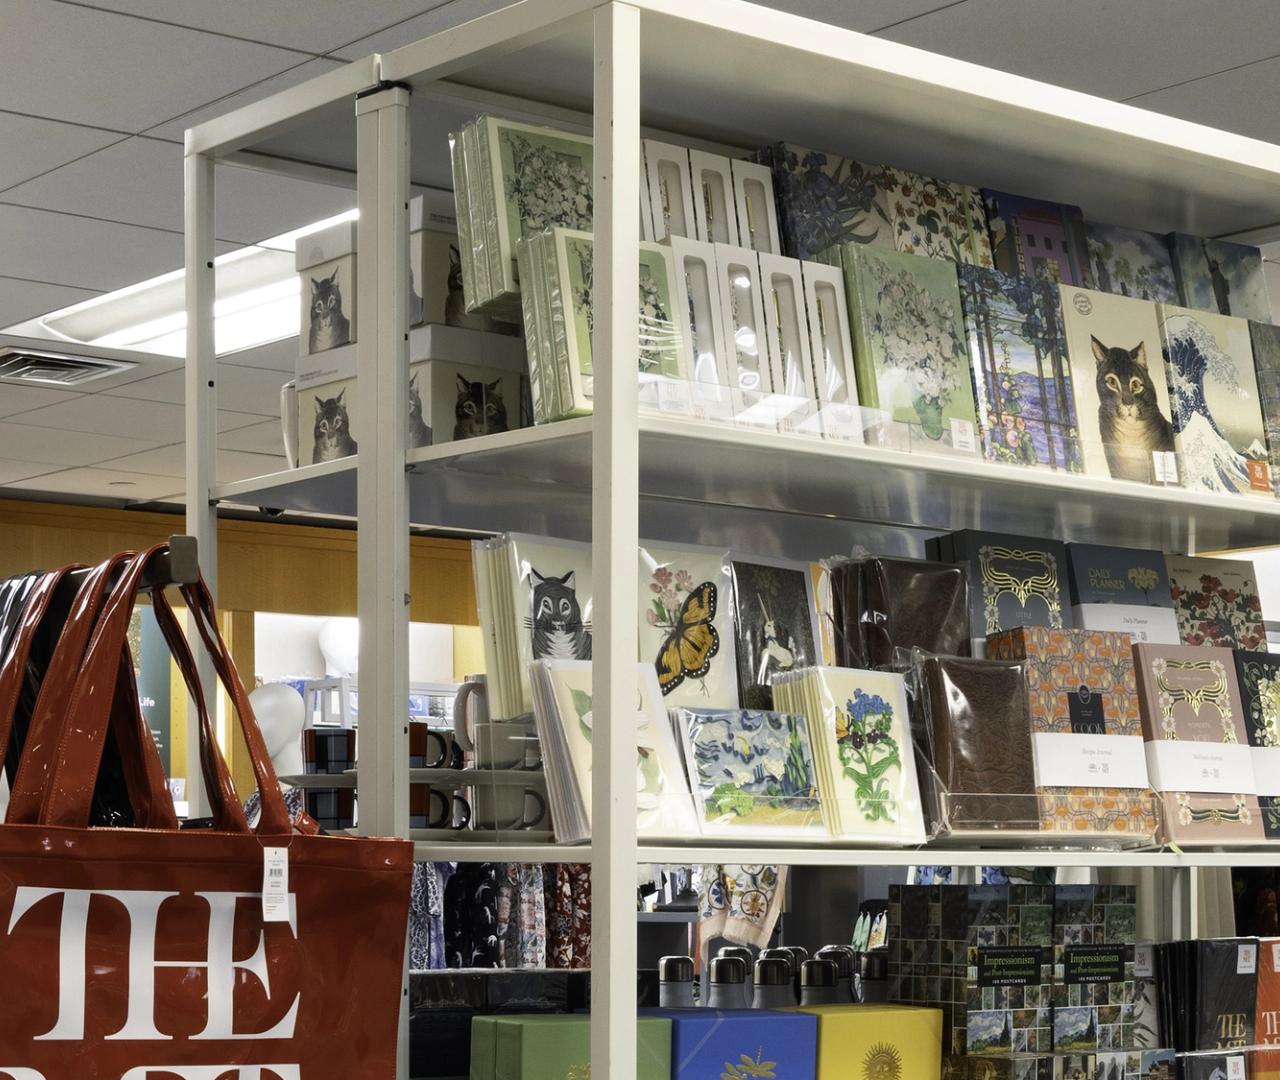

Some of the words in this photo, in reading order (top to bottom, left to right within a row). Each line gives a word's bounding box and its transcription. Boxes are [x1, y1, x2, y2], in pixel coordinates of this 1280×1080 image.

[1088, 567, 1111, 578] DAILY
[1089, 578, 1125, 591] PLANNER
[7, 885, 302, 1041] THE
[984, 954, 1035, 966] Impressionism
[1070, 953, 1119, 964] Impressionism
[1217, 1013, 1247, 1038] THE
